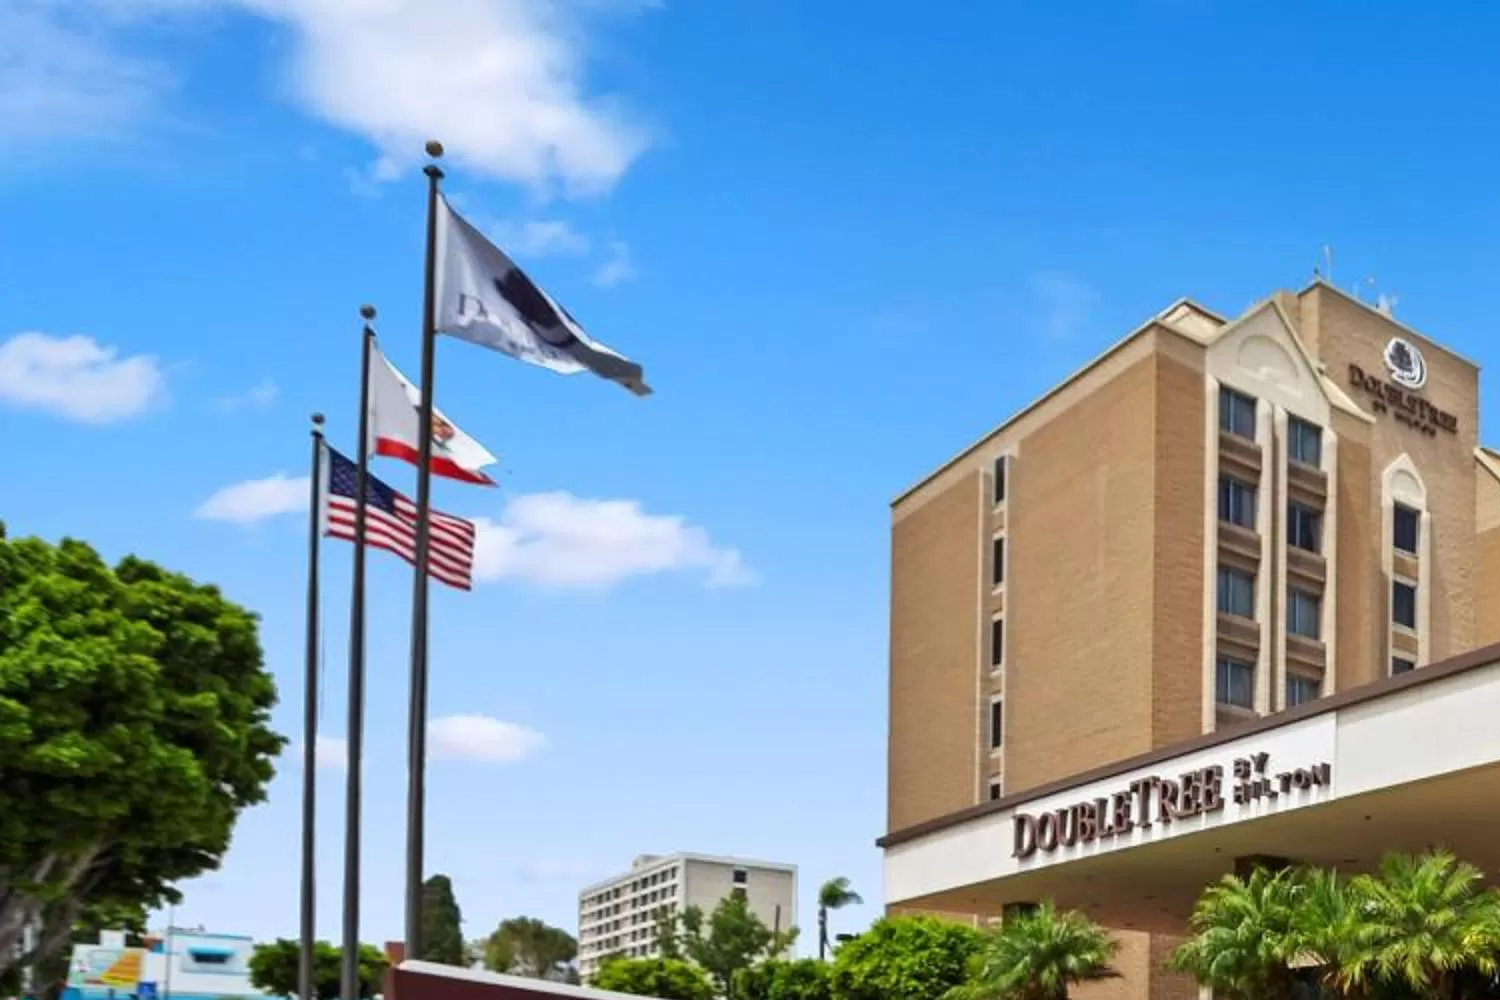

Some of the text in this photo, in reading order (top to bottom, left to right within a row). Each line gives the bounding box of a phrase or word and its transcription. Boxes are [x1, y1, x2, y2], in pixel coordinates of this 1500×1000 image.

[1234, 752, 1269, 779] BY
[1234, 763, 1332, 804] HILTON
[1012, 765, 1225, 859] DOUBLETREE
